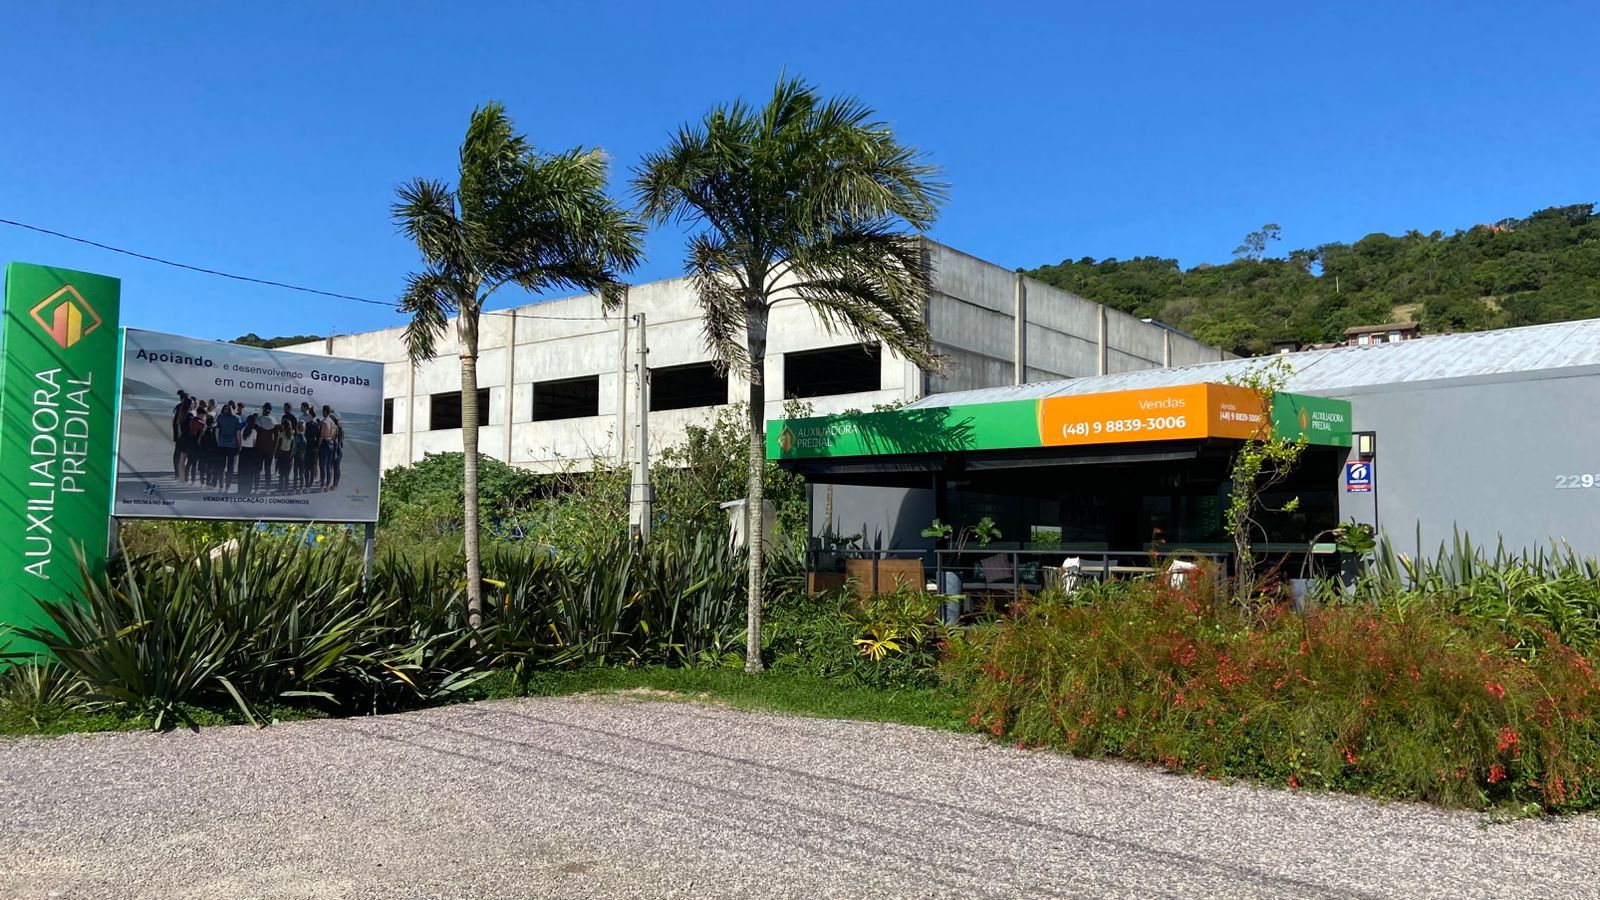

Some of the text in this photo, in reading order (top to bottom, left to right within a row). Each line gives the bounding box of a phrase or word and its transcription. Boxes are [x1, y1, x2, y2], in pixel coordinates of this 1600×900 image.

[136, 348, 370, 387] Apoiando e desenvolvendo Garopaba
[215, 377, 314, 396] em comunidade
[1138, 397, 1186, 410] Vendas
[1311, 411, 1344, 423] AUXILIADORA
[61, 371, 92, 493] PREDIAL
[797, 424, 858, 438] AUXILIADORA
[1062, 415, 1186, 438] (48) 9 8839-3006
[1311, 420, 1332, 431] PREDIAL
[797, 437, 833, 448] PREDIAL
[24, 368, 62, 580] AUXILIADORA
